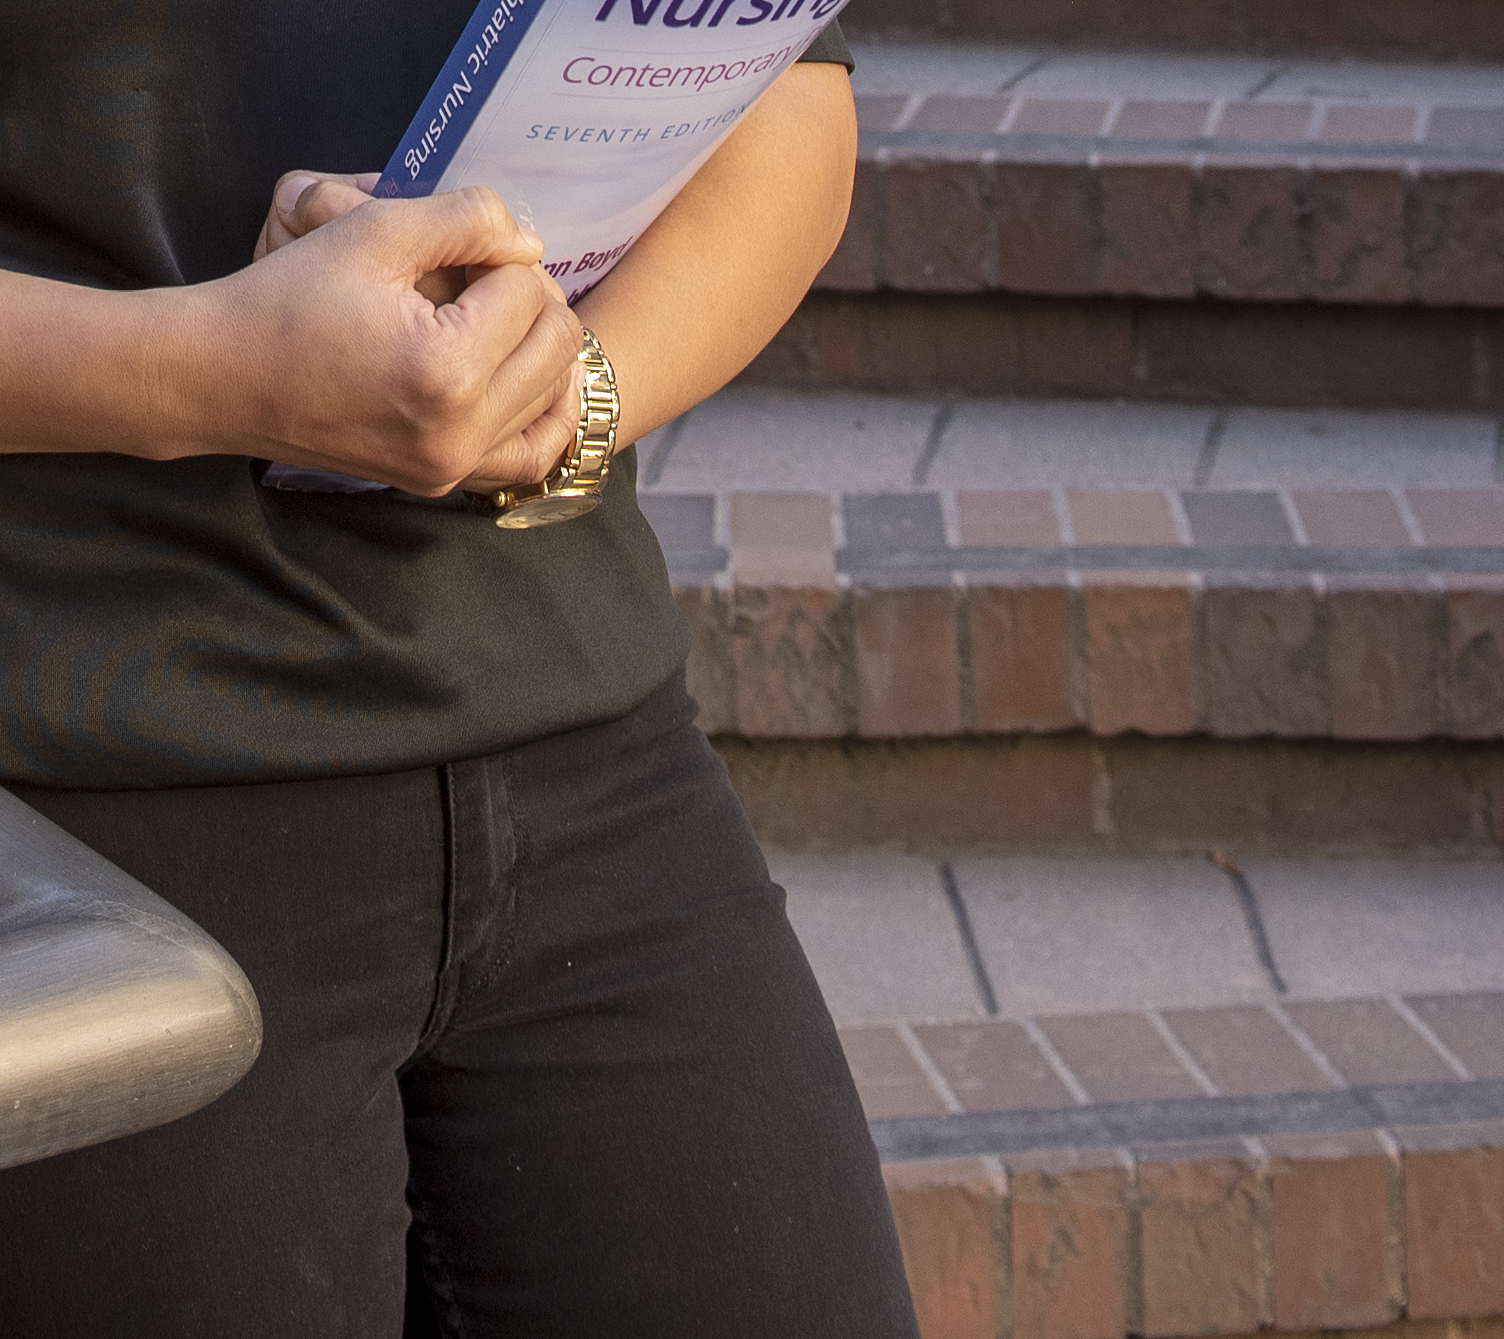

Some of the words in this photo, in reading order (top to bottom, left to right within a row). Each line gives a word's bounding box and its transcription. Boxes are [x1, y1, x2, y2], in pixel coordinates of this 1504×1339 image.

[562, 39, 802, 93] Contemporary
[404, 70, 473, 181] Nursing
[526, 124, 652, 144] SEVENTH
[660, 100, 751, 140] EDITION
[538, 259, 573, 279] nn
[573, 235, 634, 273] Boyd
